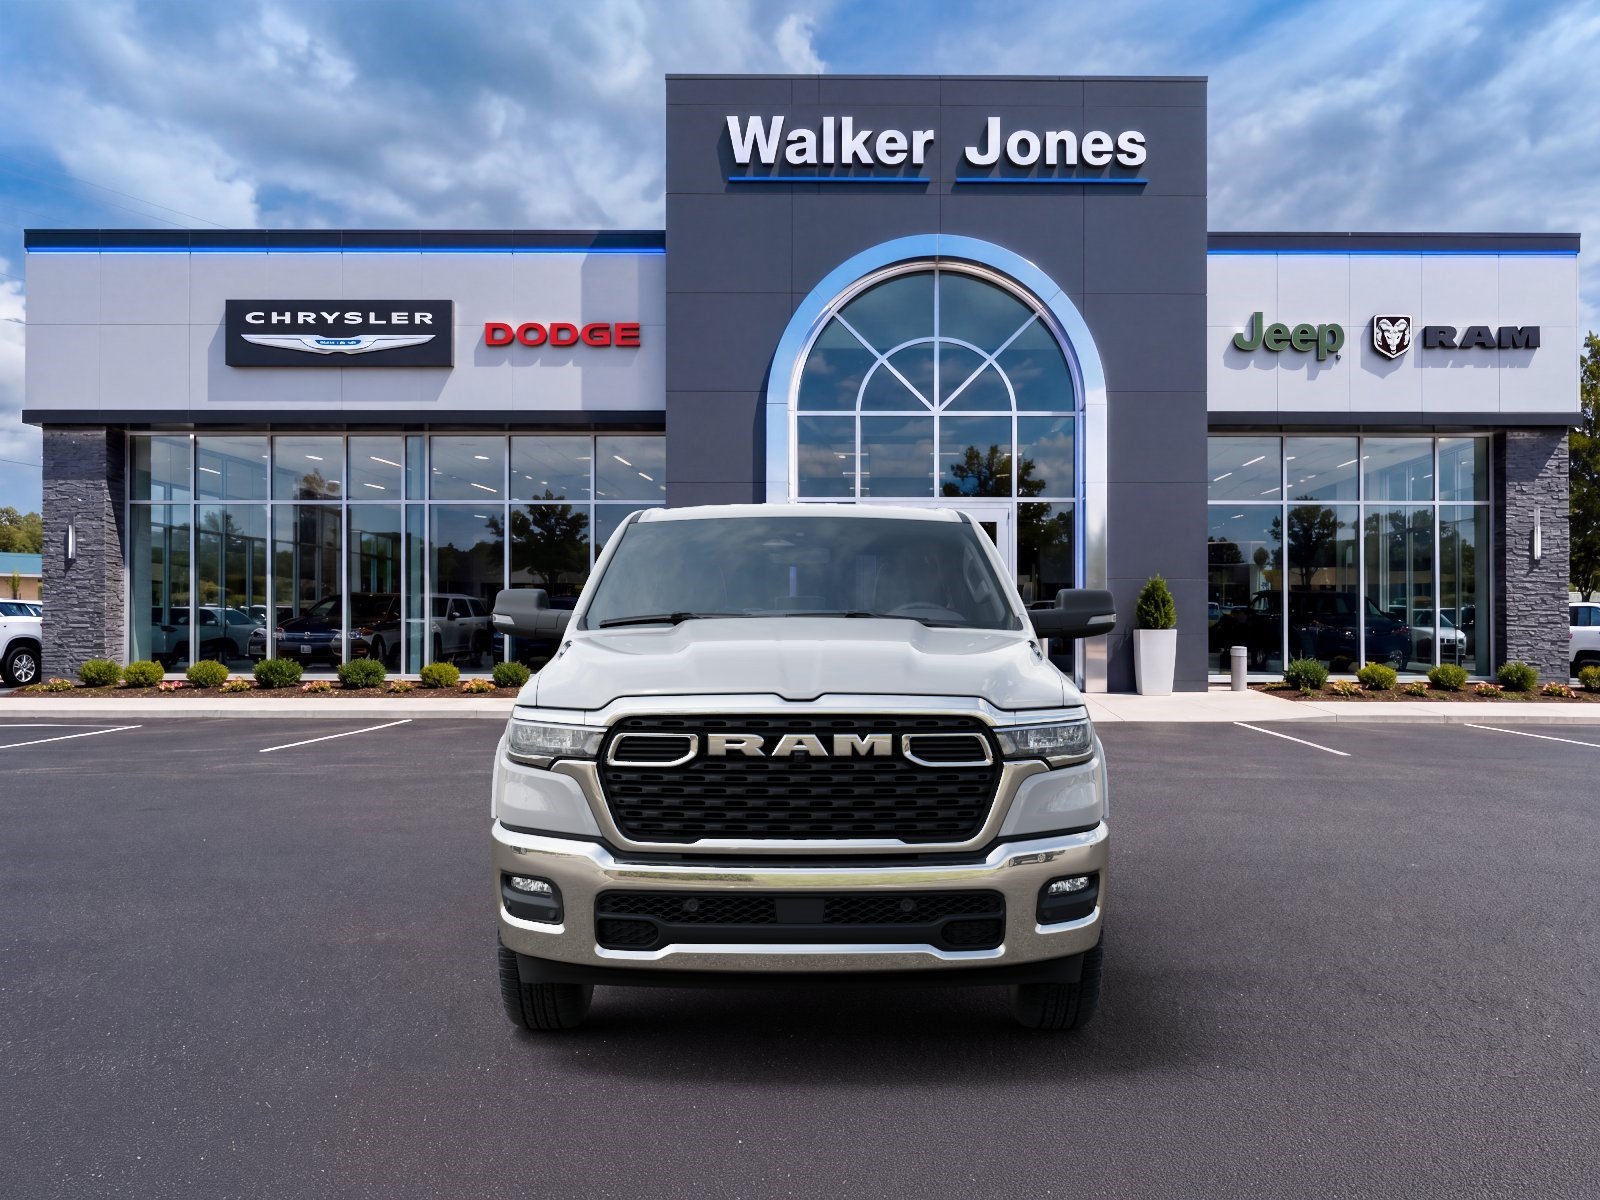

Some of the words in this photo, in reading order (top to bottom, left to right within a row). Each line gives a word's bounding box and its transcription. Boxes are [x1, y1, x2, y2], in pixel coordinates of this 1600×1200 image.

[726, 115, 934, 165] Walker
[965, 116, 1147, 166] Jones
[245, 311, 433, 325] CHRYSLER
[484, 322, 641, 347] DODGE
[1233, 311, 1345, 360] Jeep
[1424, 325, 1540, 348] RAM
[706, 733, 893, 757] RAM
